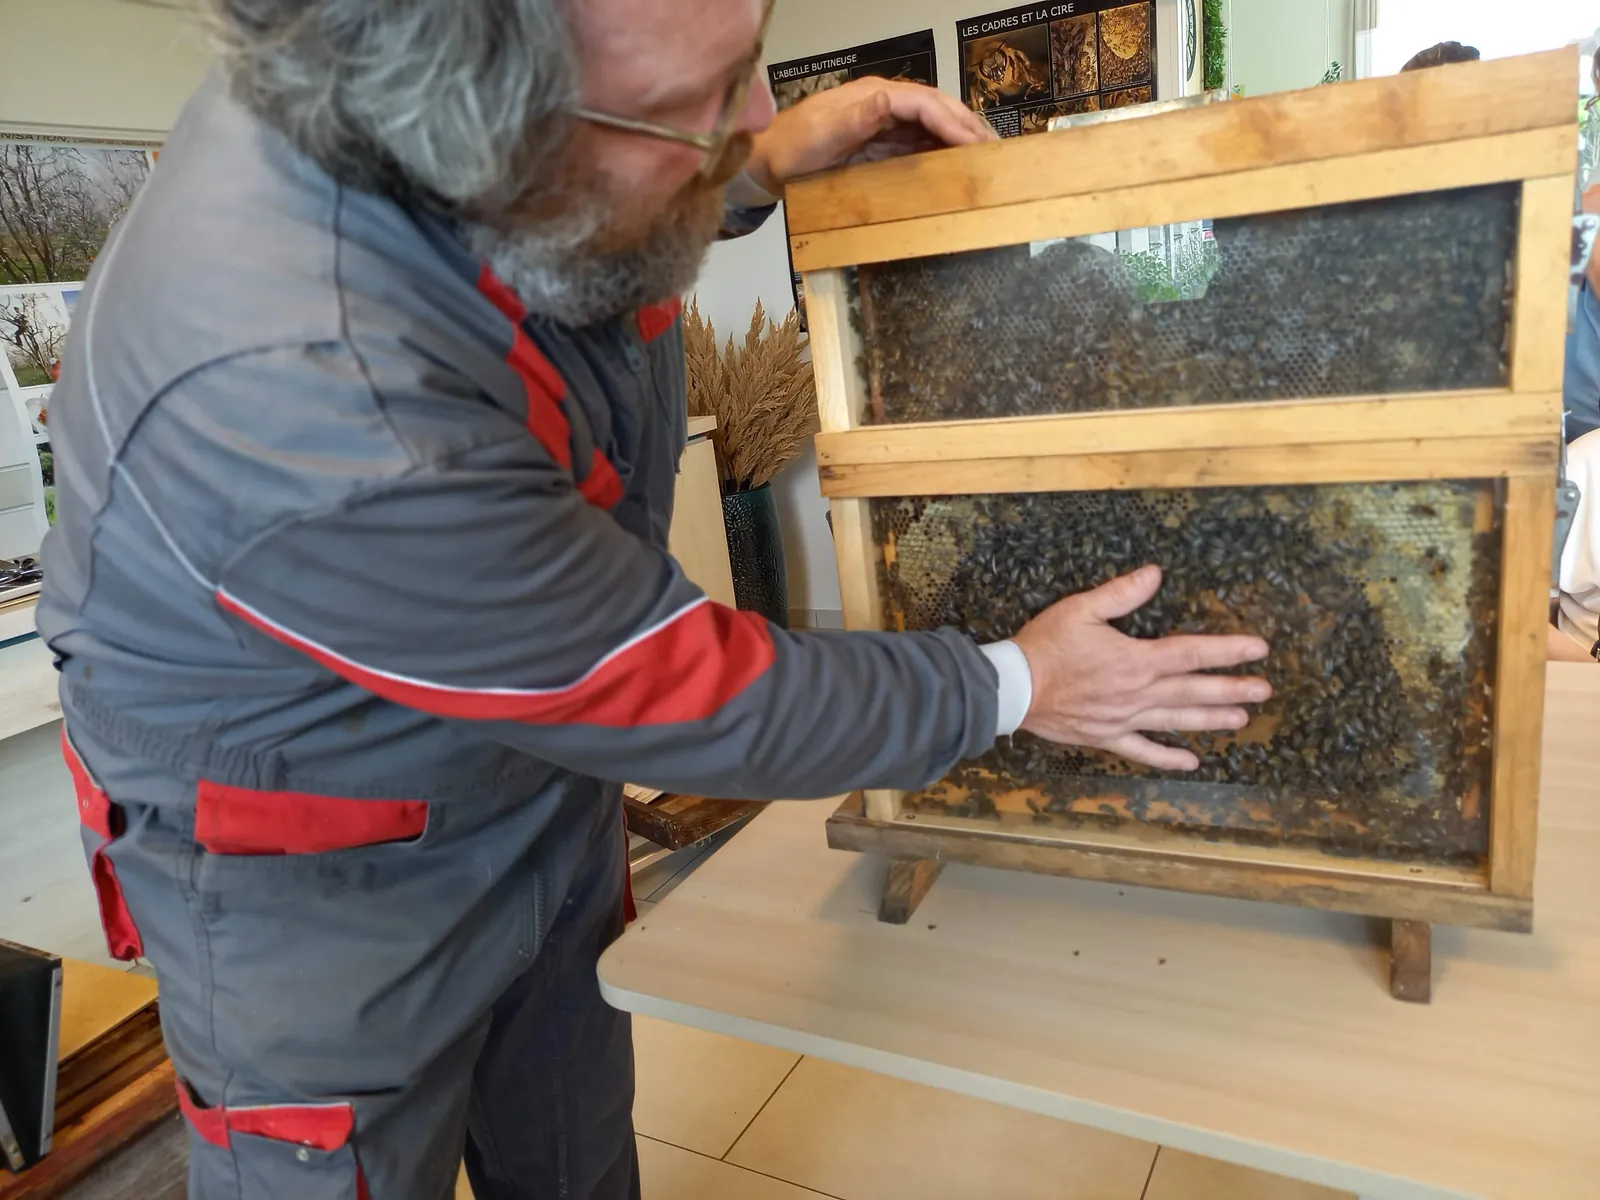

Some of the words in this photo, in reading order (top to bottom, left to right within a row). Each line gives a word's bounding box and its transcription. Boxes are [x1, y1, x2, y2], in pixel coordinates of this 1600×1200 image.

[962, 25, 979, 37] LES
[981, 16, 1019, 32] CADRES
[1021, 12, 1034, 23] ET
[1036, 9, 1048, 20] LA
[1050, 2, 1074, 17] CIRE
[773, 64, 810, 80] L'ABEILLE
[811, 53, 858, 72] BUTINEUSE
